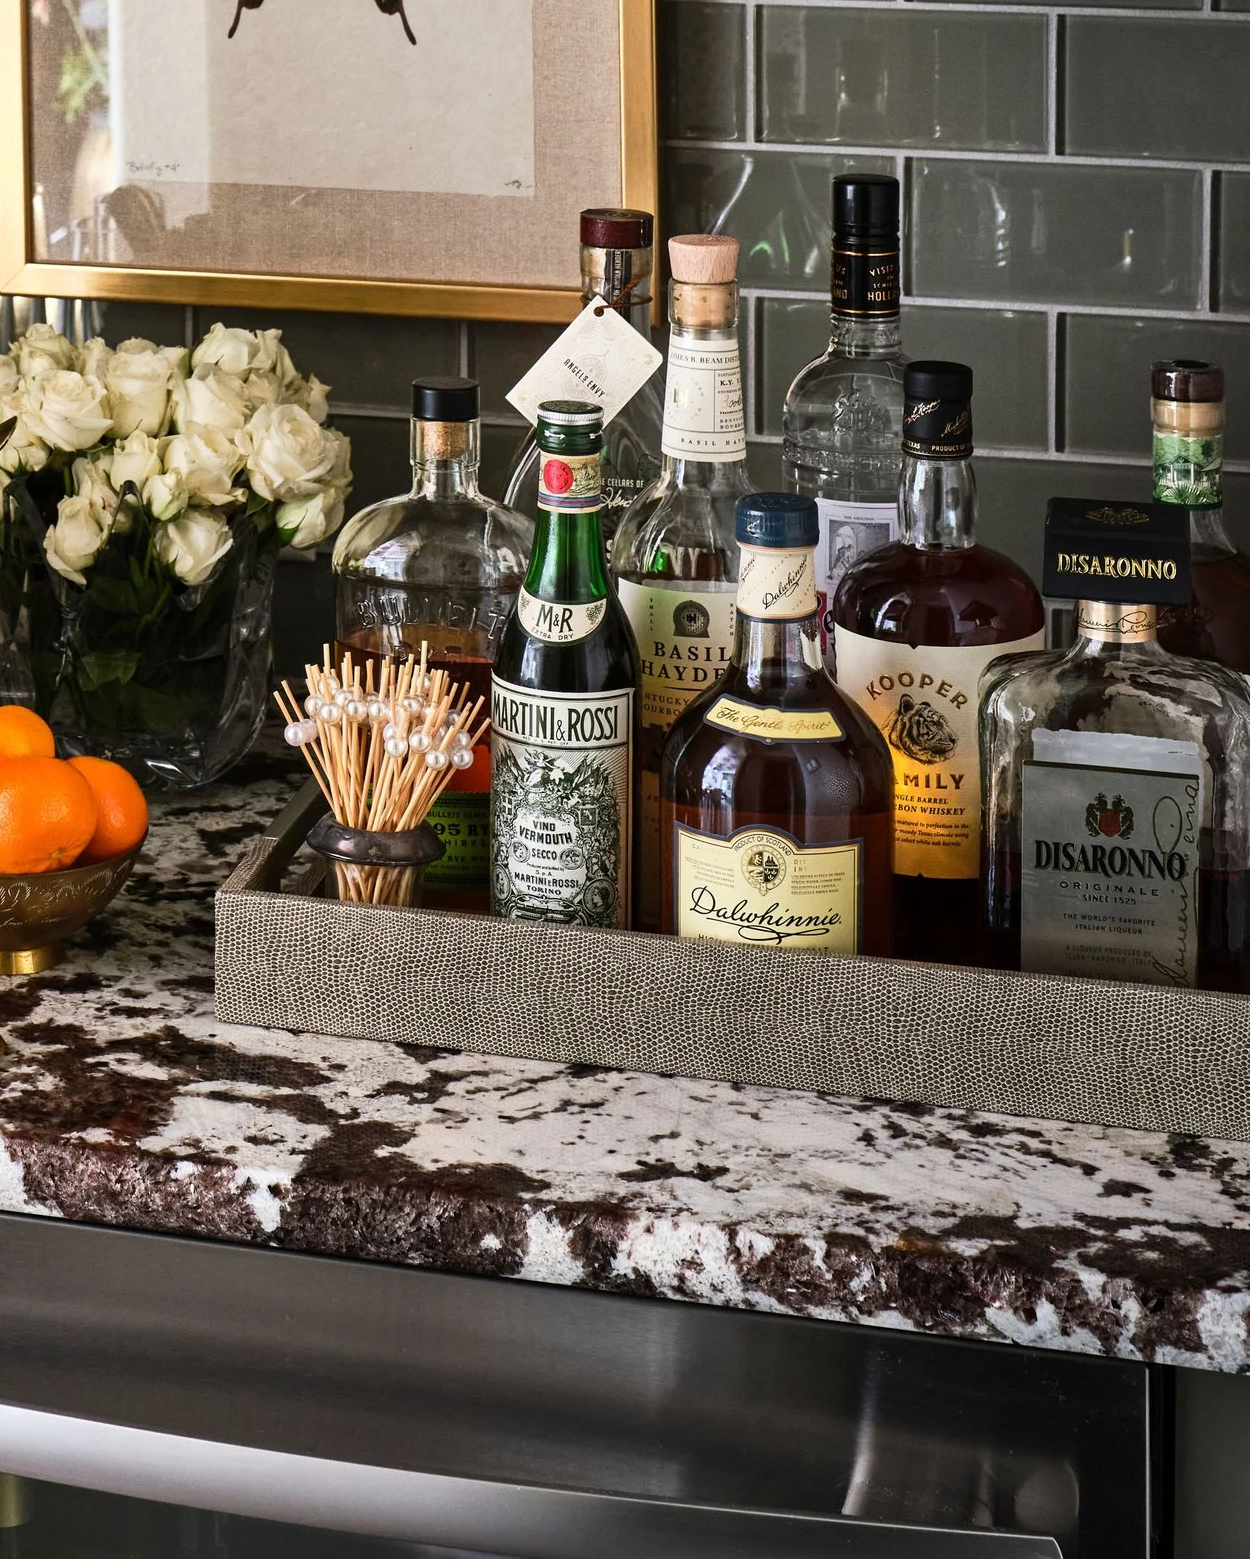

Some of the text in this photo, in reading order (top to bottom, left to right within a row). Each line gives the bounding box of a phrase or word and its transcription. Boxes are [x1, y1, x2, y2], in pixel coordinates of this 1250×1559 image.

[869, 264, 894, 276] VISIT
[587, 380, 606, 399] ENVY
[681, 438, 717, 446] BASIL
[607, 478, 634, 488] CELLARS
[635, 479, 644, 488] OF
[1056, 552, 1177, 580] DISARONNO
[357, 595, 506, 640] BULLEIT
[536, 603, 574, 634] M&R
[531, 627, 574, 641] EXTRA DRY
[653, 641, 732, 662] BASIL
[641, 659, 727, 682] HAYDE
[865, 672, 968, 710] KOOPER
[644, 692, 690, 705] NTUCKY
[492, 690, 555, 740] MARTINI
[567, 705, 618, 742] ROSSI
[643, 703, 681, 717] OURBO
[741, 714, 783, 733] Gentle
[893, 772, 965, 790] MILY
[894, 794, 949, 805] NGLE BARREL
[920, 806, 966, 816] WHISKEY
[433, 823, 461, 836] 95
[532, 820, 556, 832] VINO
[519, 825, 573, 845] VERMOUTH
[916, 838, 930, 846] white
[734, 836, 755, 852] PRODUCT
[765, 836, 792, 856] SCOTLAND
[531, 848, 557, 860] SECCO
[1034, 839, 1187, 882] DISARONNO
[514, 872, 548, 886] MARTINI
[553, 878, 579, 889] ROSSI
[526, 885, 562, 895] TORINO
[1059, 880, 1159, 897] ORIGINALE
[1082, 893, 1137, 906] SINCE 1525
[1080, 914, 1116, 922] WORLD'S
[1119, 916, 1156, 927] FAVORITE
[1075, 923, 1143, 935] ITALIAN LIQUEUR
[1072, 945, 1102, 953] LIQUEUR
[1104, 947, 1141, 956] PRODUCED
